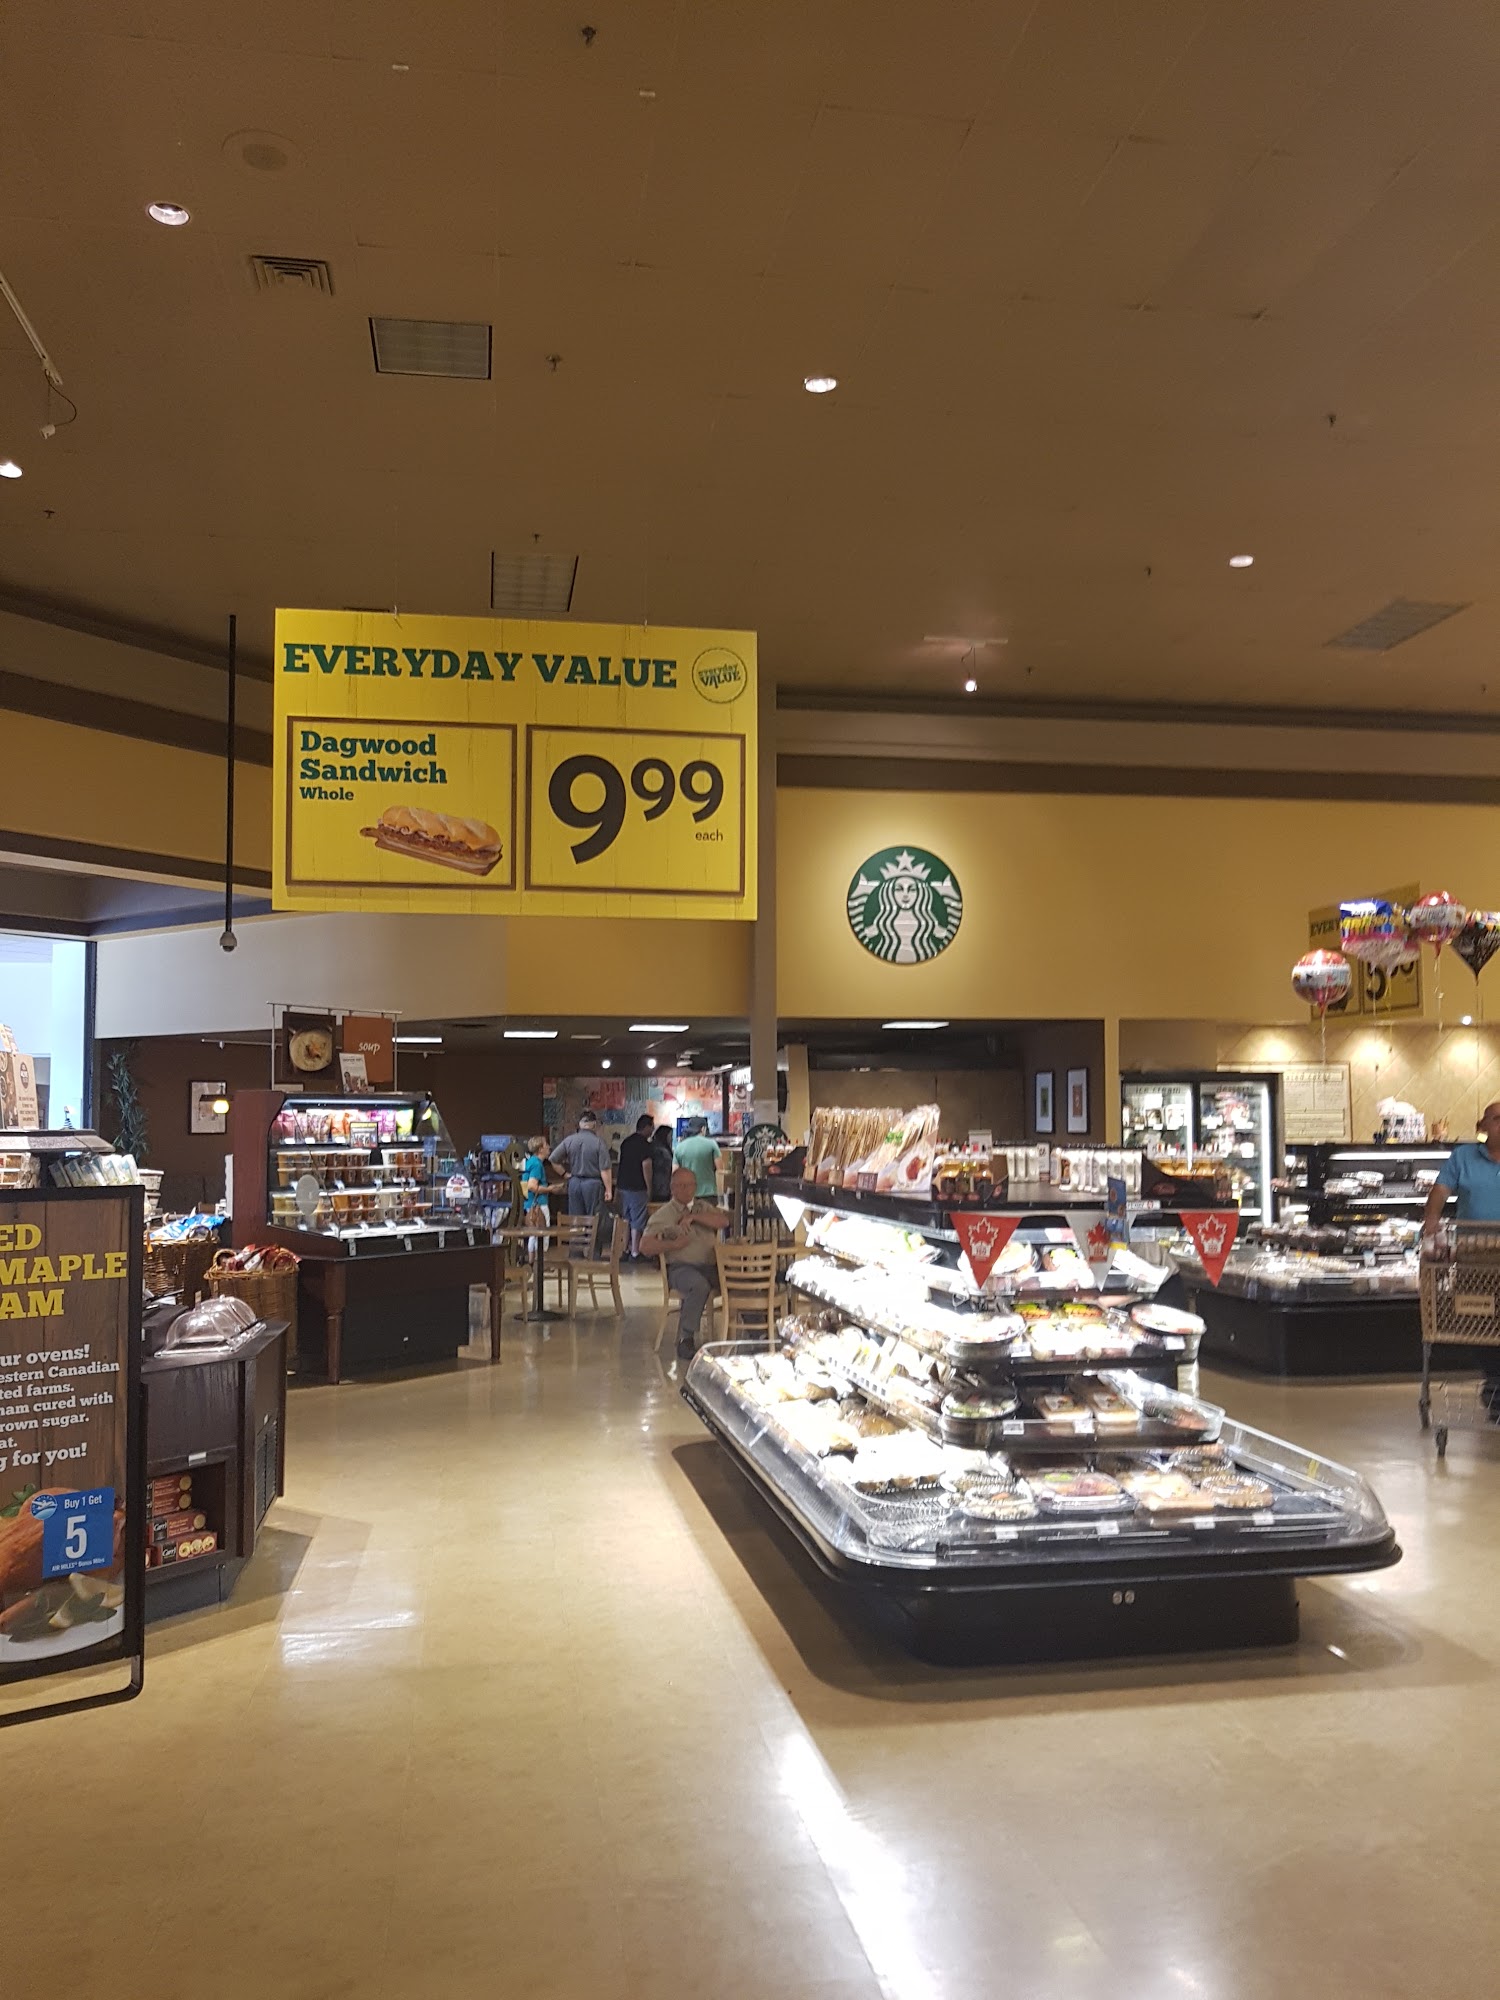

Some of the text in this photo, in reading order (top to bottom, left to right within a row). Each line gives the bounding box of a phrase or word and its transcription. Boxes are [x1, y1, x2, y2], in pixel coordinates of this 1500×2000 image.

[283, 643, 677, 688] EVERYDAY VALUE
[301, 731, 437, 758] Dagwood
[300, 757, 448, 784] Sandwich
[300, 786, 354, 801] Whole
[695, 829, 724, 842] each
[359, 1042, 381, 1055] soup
[0, 1252, 127, 1286] MAPLE
[0, 1289, 64, 1320] AM
[26, 1344, 90, 1364] ovens!
[48, 1361, 120, 1378] Canadian
[26, 1383, 75, 1397] farms.
[33, 1396, 76, 1412] cured
[80, 1391, 114, 1407] with
[42, 1413, 90, 1428] sugar.
[12, 1450, 41, 1467] for
[45, 1442, 87, 1467] you!
[64, 1494, 102, 1509] Buy 1 Get
[65, 1514, 87, 1559] 5
